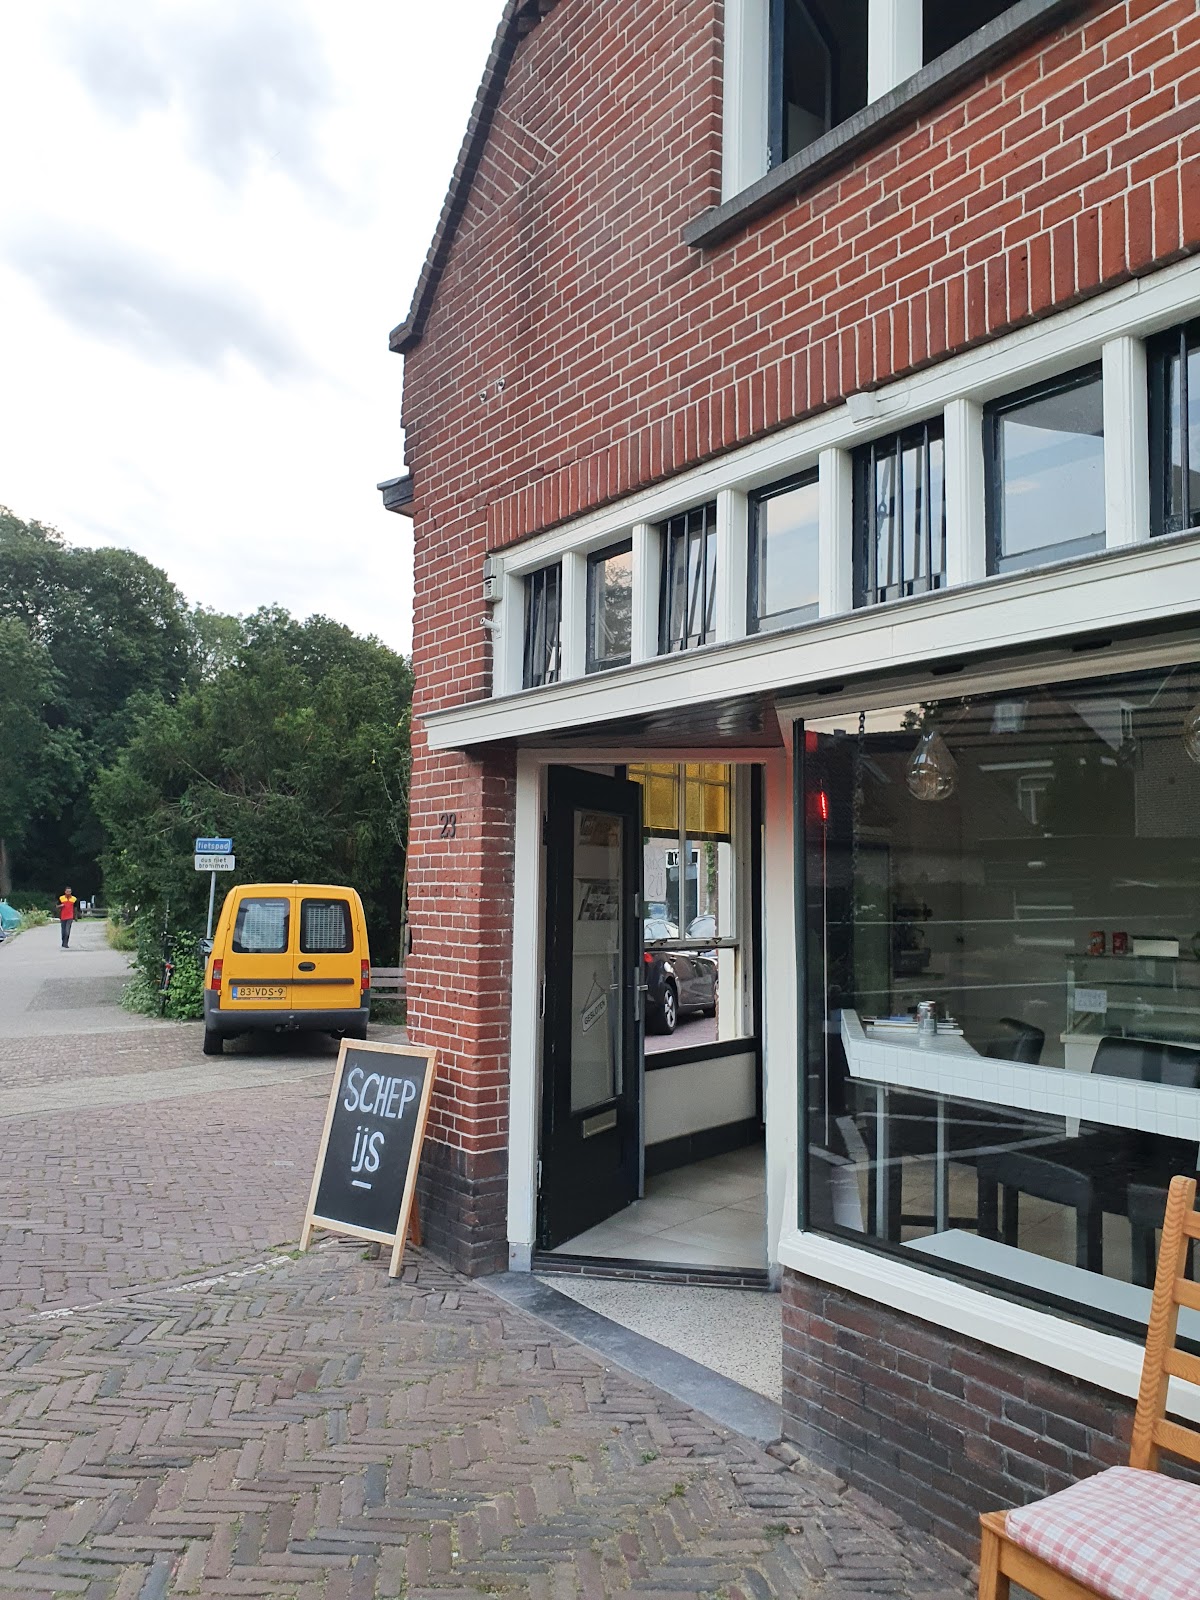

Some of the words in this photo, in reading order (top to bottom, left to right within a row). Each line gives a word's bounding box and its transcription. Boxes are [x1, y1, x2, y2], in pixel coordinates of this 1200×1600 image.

[440, 812, 457, 839] 23
[239, 987, 284, 997] 83-VDS-9
[344, 1067, 417, 1119] SCHEP
